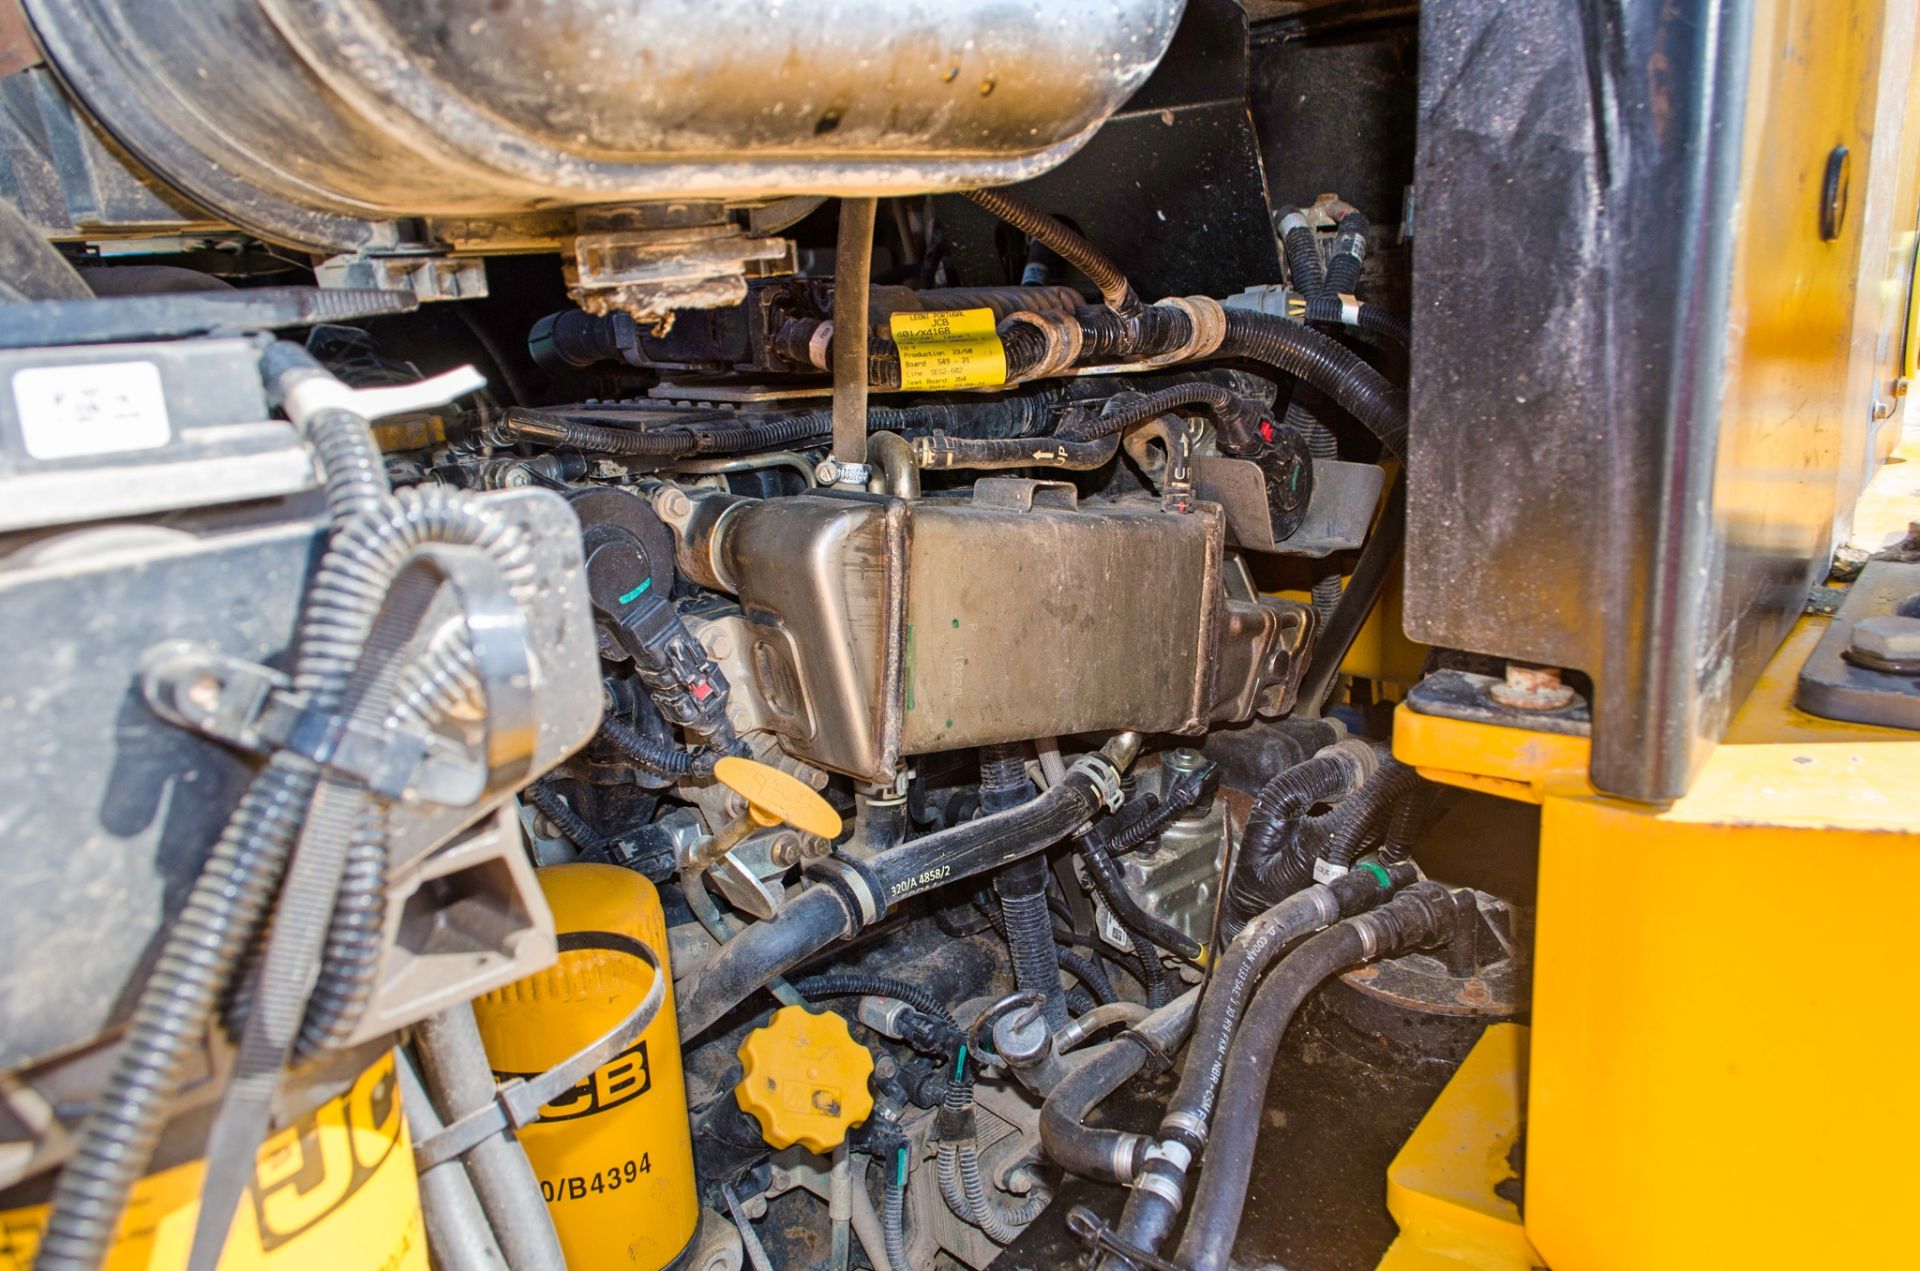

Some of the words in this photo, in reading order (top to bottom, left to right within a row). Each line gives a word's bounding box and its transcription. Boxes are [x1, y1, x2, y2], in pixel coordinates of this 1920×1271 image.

[931, 318, 950, 328] JCB
[904, 350, 945, 359] Production
[905, 360, 927, 368] Board
[926, 378, 948, 386] Board
[1054, 445, 1069, 466] UP
[890, 876, 918, 897] 320/A
[918, 864, 951, 884] 4858/2
[1246, 936, 1268, 963] CODAN
[1232, 978, 1244, 998] SAE
[535, 1049, 648, 1119] CB
